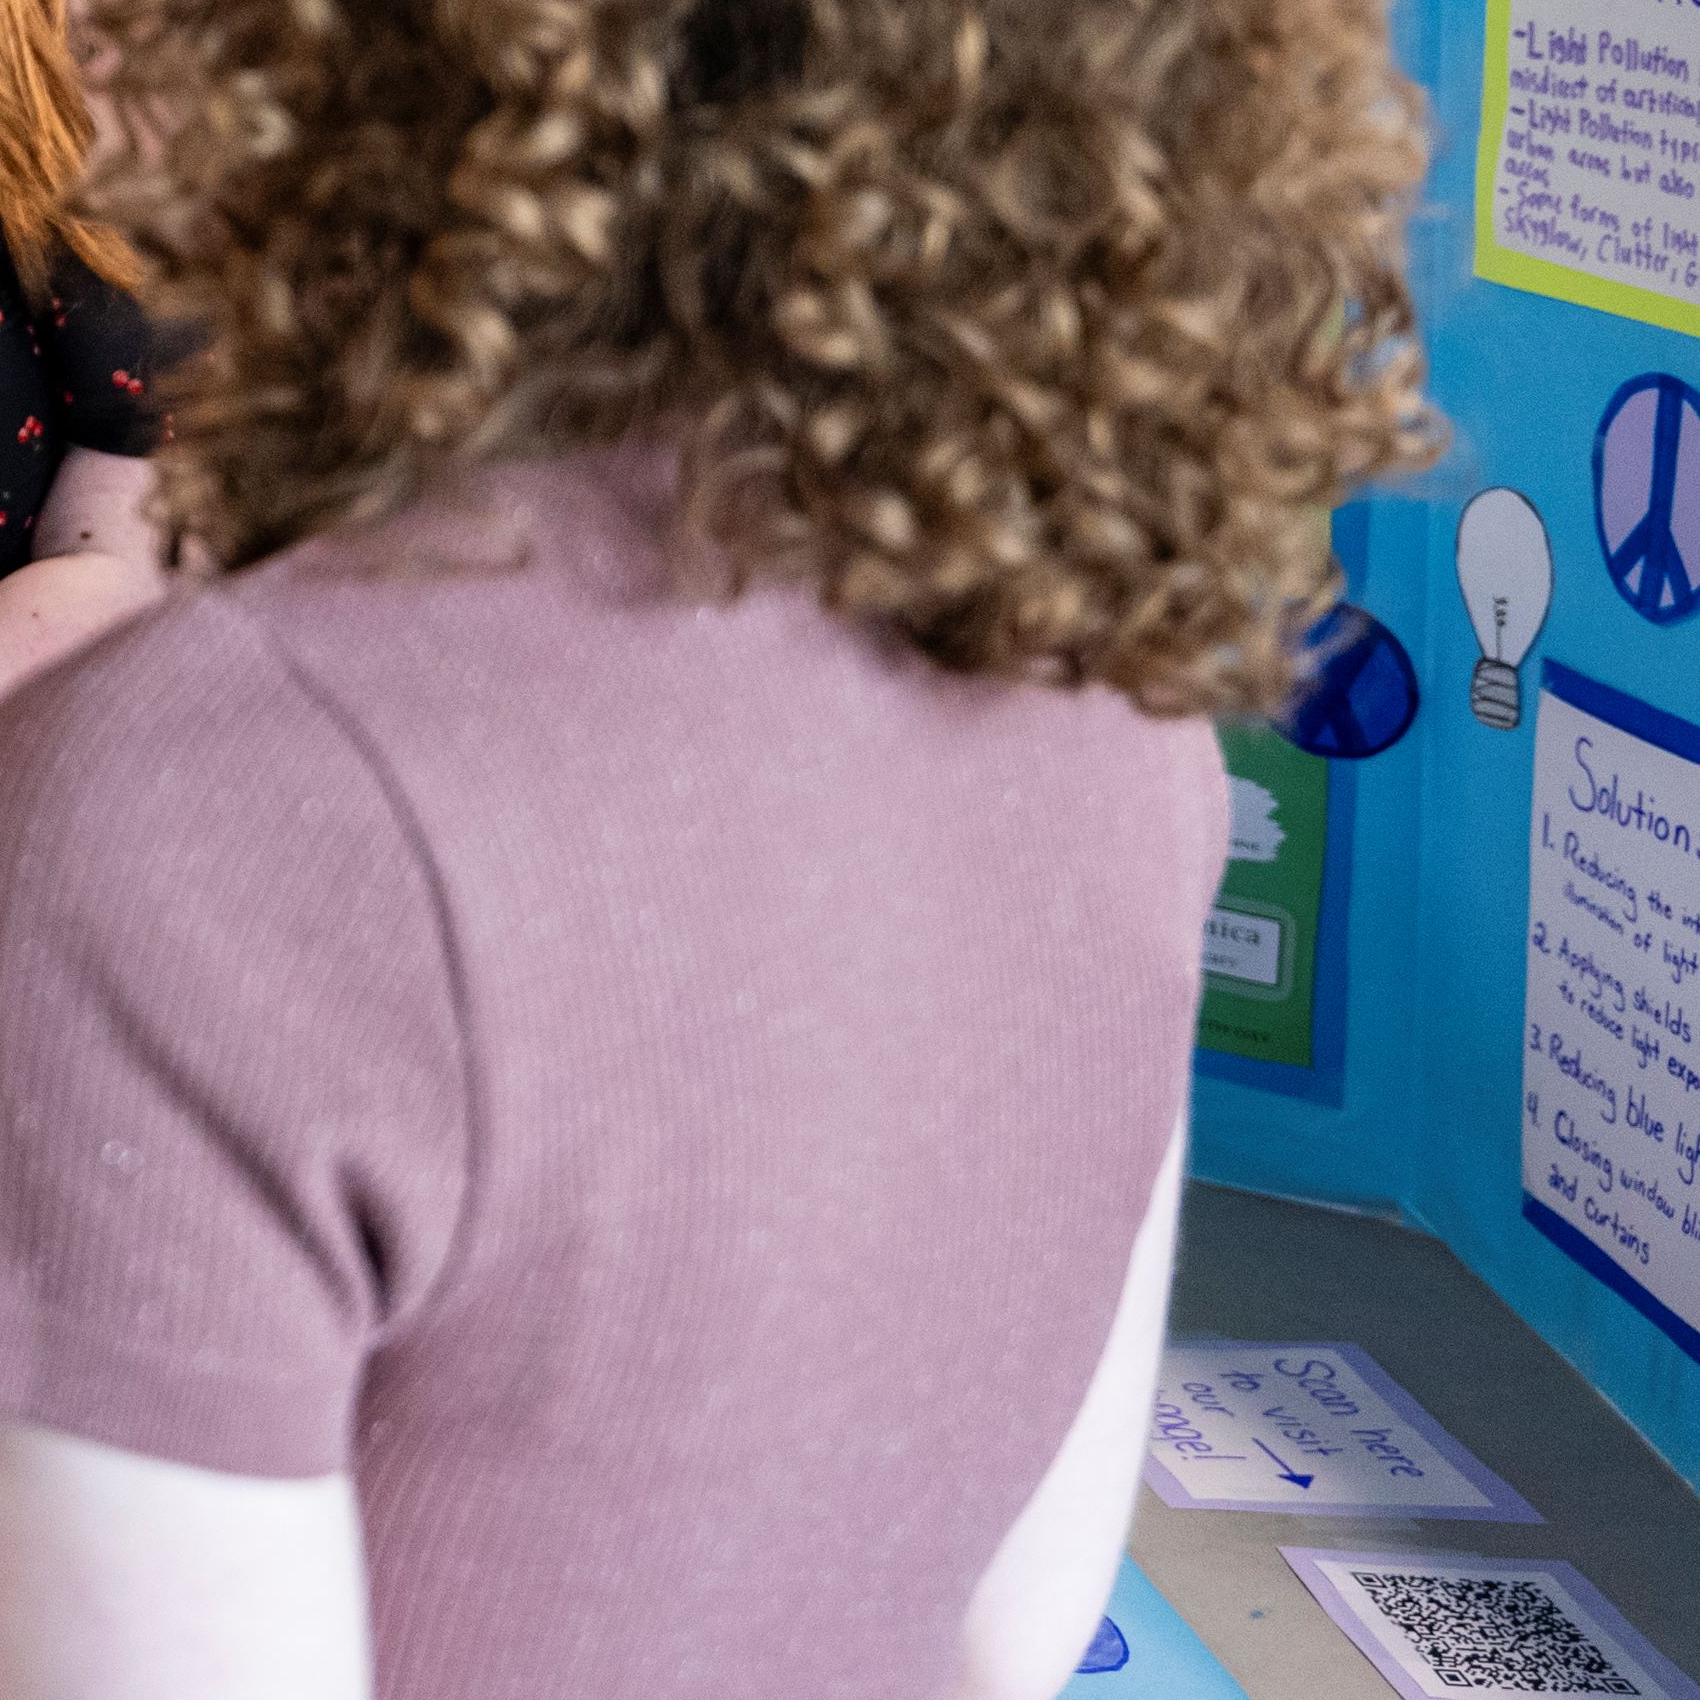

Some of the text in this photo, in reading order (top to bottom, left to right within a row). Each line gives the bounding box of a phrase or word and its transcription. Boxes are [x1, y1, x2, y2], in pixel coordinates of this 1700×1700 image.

[1598, 30, 1690, 83] Pollution
[1595, 78, 1617, 104] of
[1579, 108, 1653, 150] Pollution
[1621, 155, 1651, 183] but
[1658, 168, 1695, 200] also
[1631, 217, 1652, 242] of
[1568, 736, 1700, 860] Solution
[1542, 813, 1555, 849] 1.
[1563, 831, 1638, 924] Reducing
[1647, 889, 1673, 920] the
[1633, 932, 1653, 953] of
[1663, 940, 1699, 984] light
[1558, 937, 1626, 1013] Applying
[1632, 986, 1692, 1044] shields
[1580, 999, 1624, 1040] reduce
[1631, 1025, 1660, 1070] light
[1549, 1033, 1617, 1125] Reducing
[1626, 1085, 1664, 1143] blue
[1548, 1163, 1578, 1202] and
[1554, 1110, 1613, 1193] Closing
[1619, 1170, 1675, 1219] window
[1181, 1382, 1235, 1417] our
[1217, 1370, 1344, 1457] to visit
[1273, 1358, 1425, 1477] Scan here
